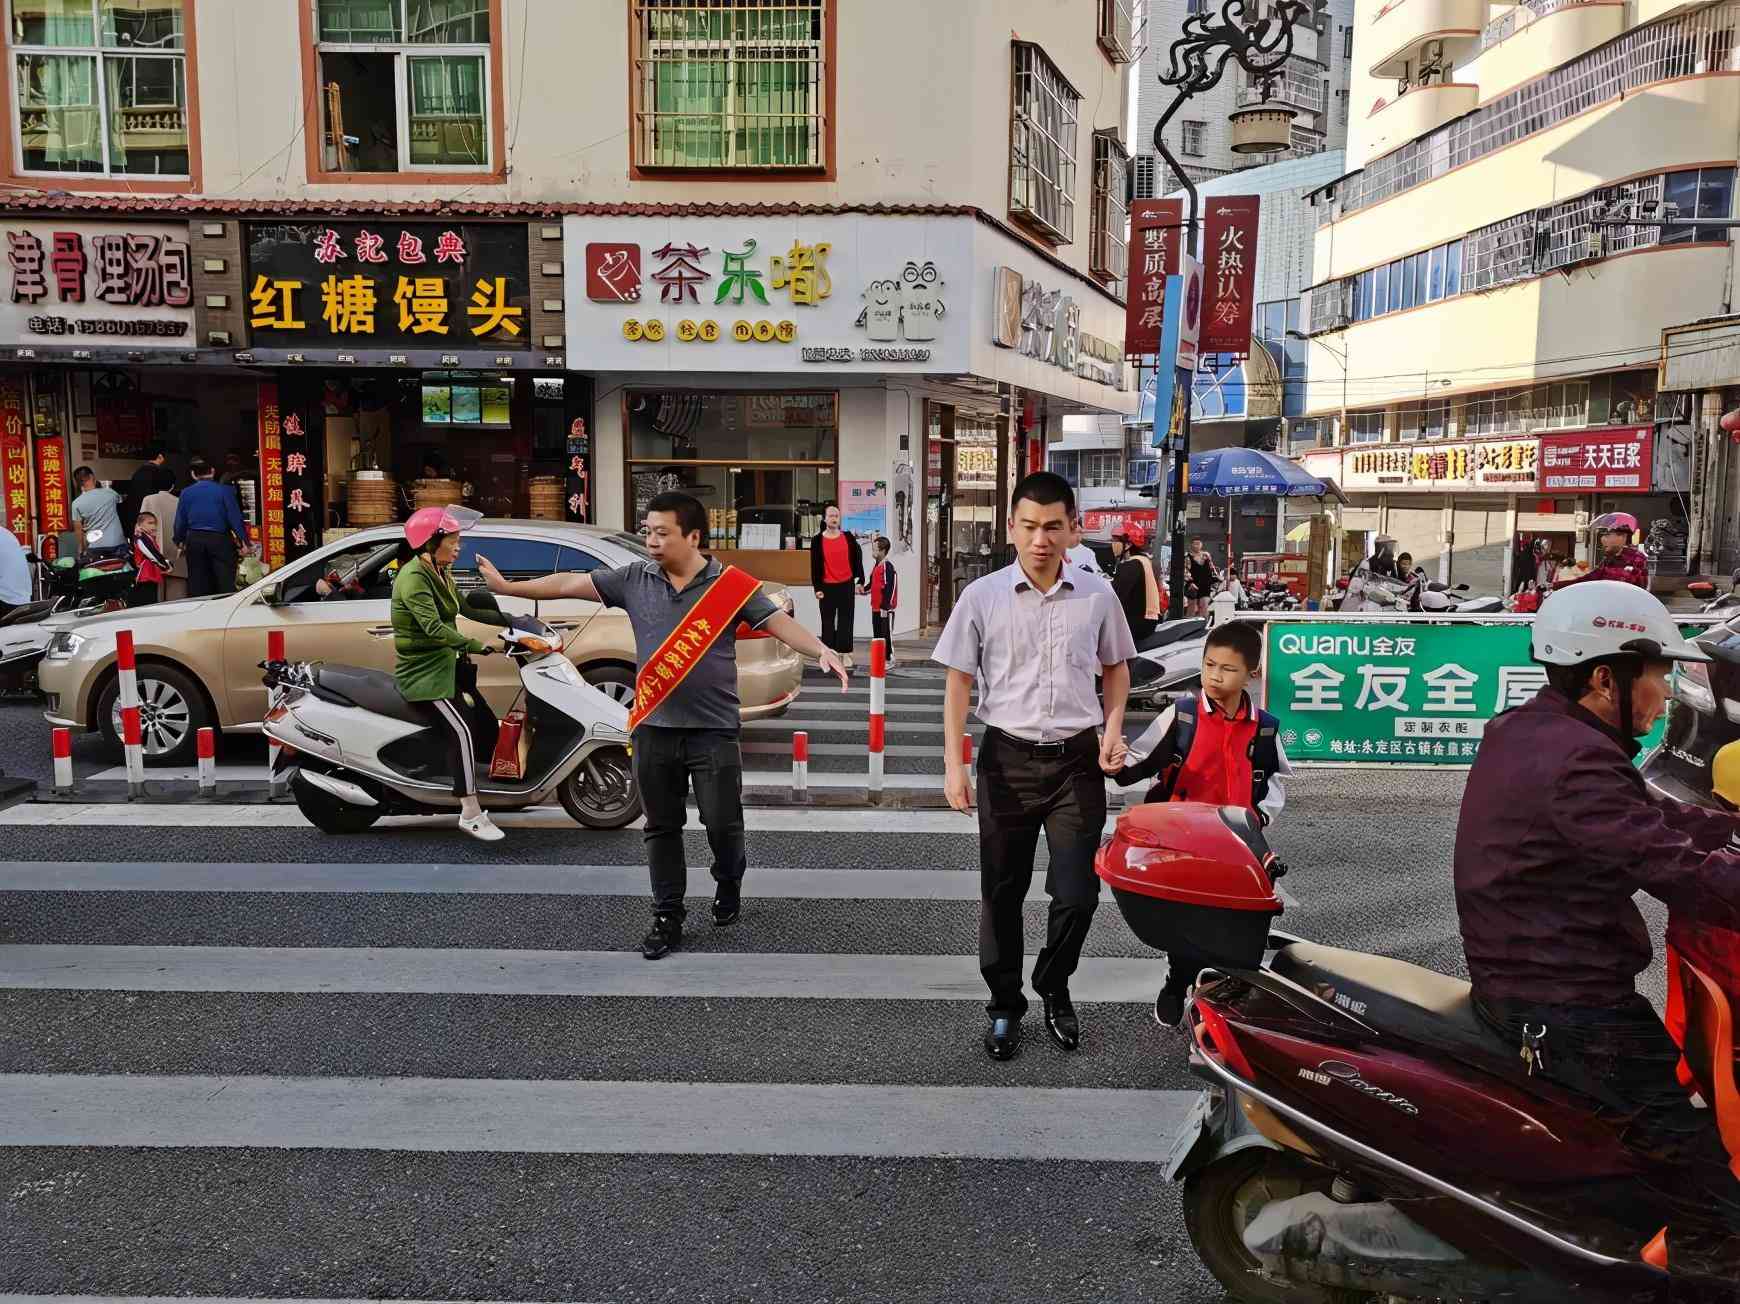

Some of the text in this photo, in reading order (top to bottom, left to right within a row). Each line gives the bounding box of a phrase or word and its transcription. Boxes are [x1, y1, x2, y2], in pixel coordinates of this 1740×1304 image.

[651, 238, 833, 306] 茶乐嘟
[1214, 225, 1244, 324] 火热认筹
[250, 274, 522, 336] 红糖馒头
[1583, 442, 1640, 469] 天天豆浆
[1279, 634, 1416, 656] Quanu 全友
[1289, 663, 1550, 713] 全友全屋
